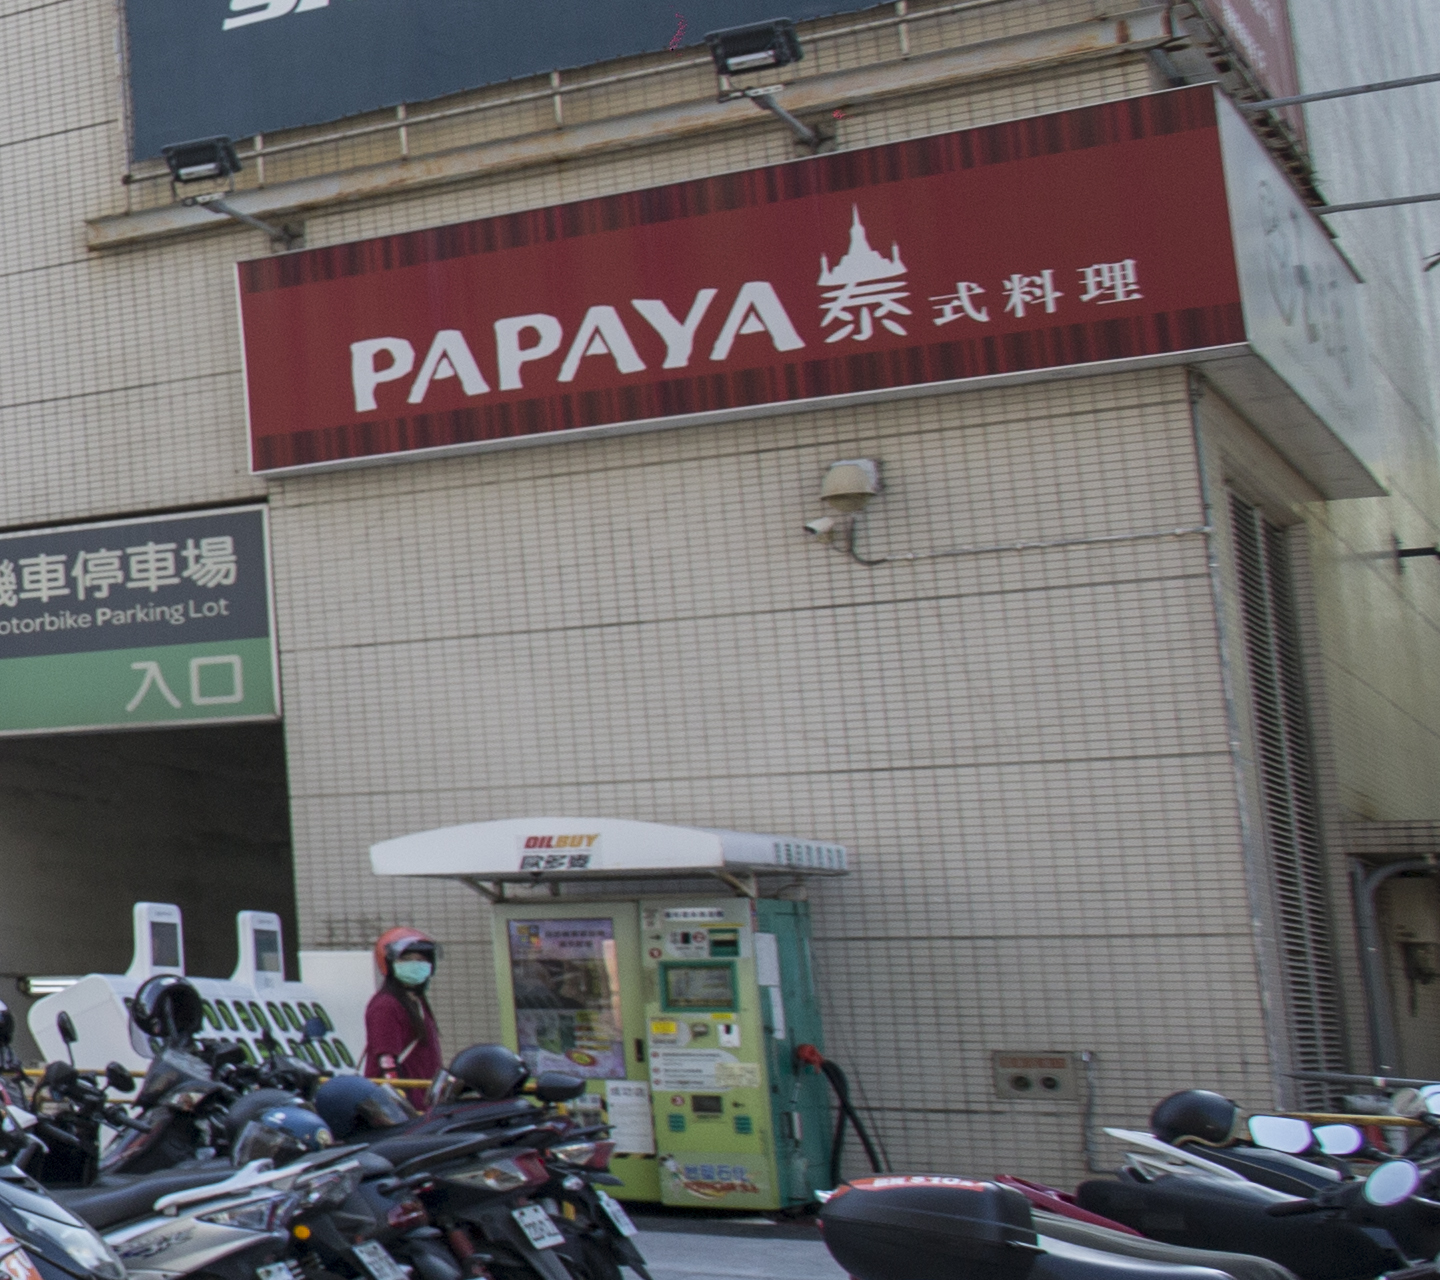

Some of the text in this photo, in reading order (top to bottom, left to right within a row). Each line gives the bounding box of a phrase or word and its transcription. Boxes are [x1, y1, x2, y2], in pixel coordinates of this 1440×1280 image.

[348, 279, 806, 413] PAPAYA
[96, 602, 186, 627] Parking
[188, 597, 231, 618] Lot
[126, 653, 243, 713] 入口
